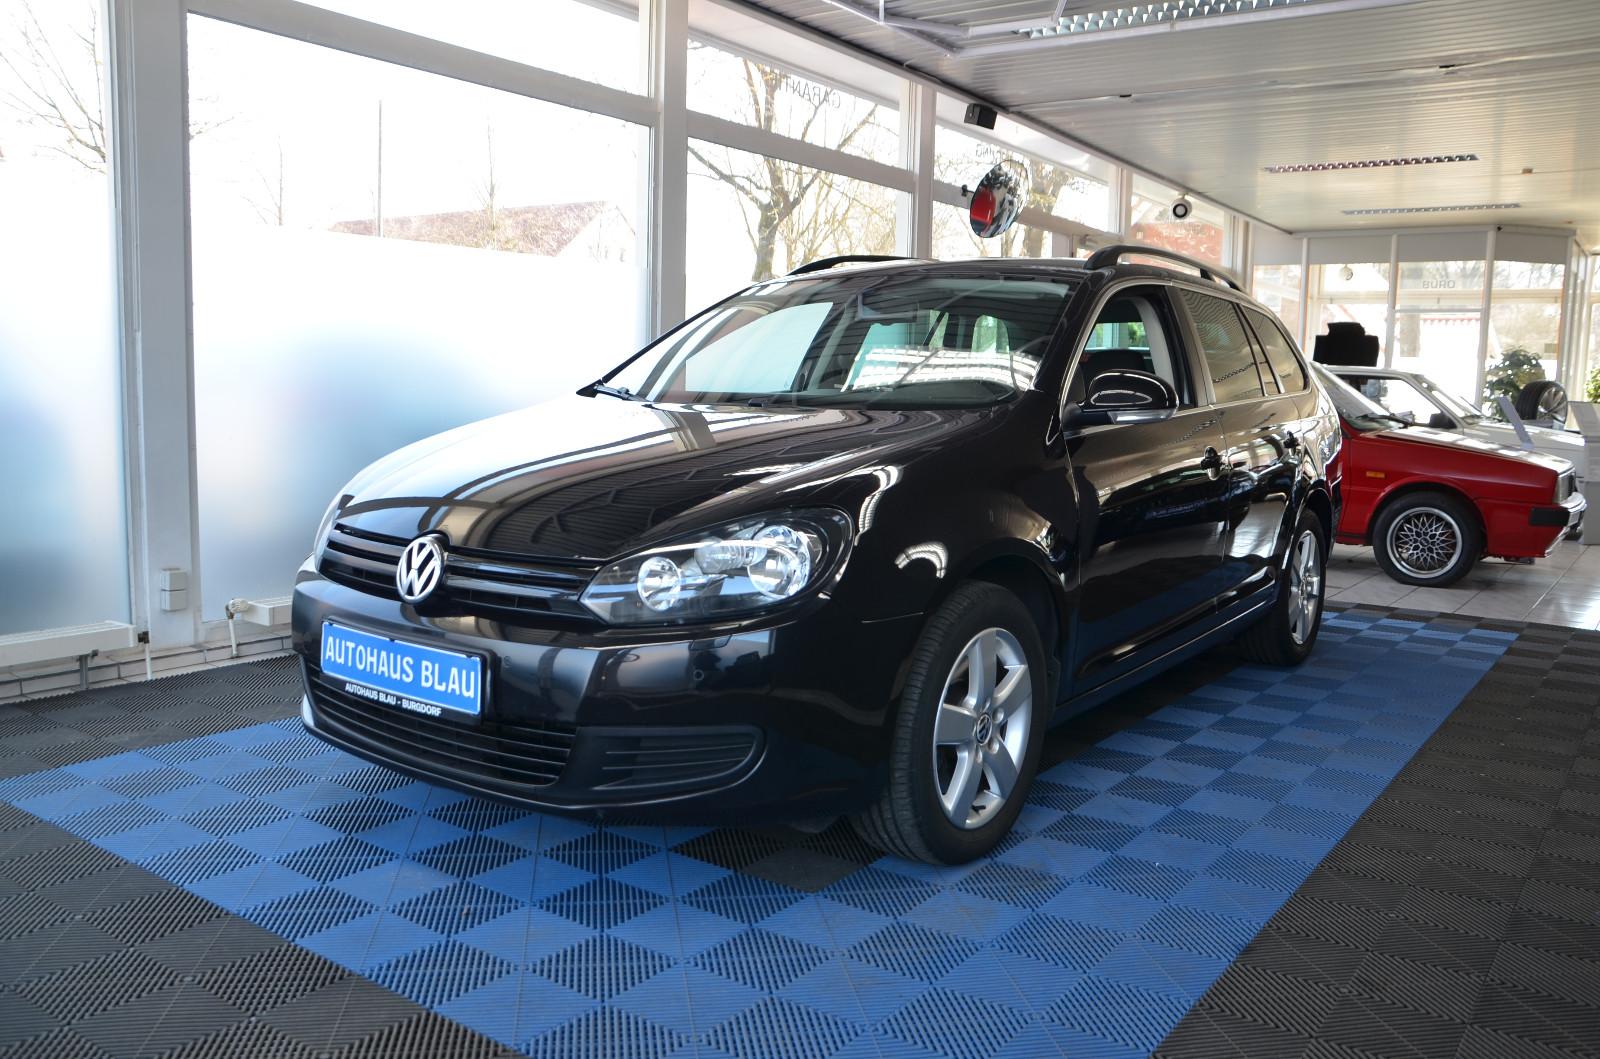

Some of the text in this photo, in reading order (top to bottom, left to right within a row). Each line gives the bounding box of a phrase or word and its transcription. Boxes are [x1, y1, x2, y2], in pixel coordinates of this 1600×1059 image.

[396, 534, 443, 600] VW
[325, 636, 475, 699] AUTOHAUS BLAU
[345, 683, 379, 700] AUTOHAUS
[379, 692, 396, 705] BLAU
[402, 699, 442, 717] BURGDORF
